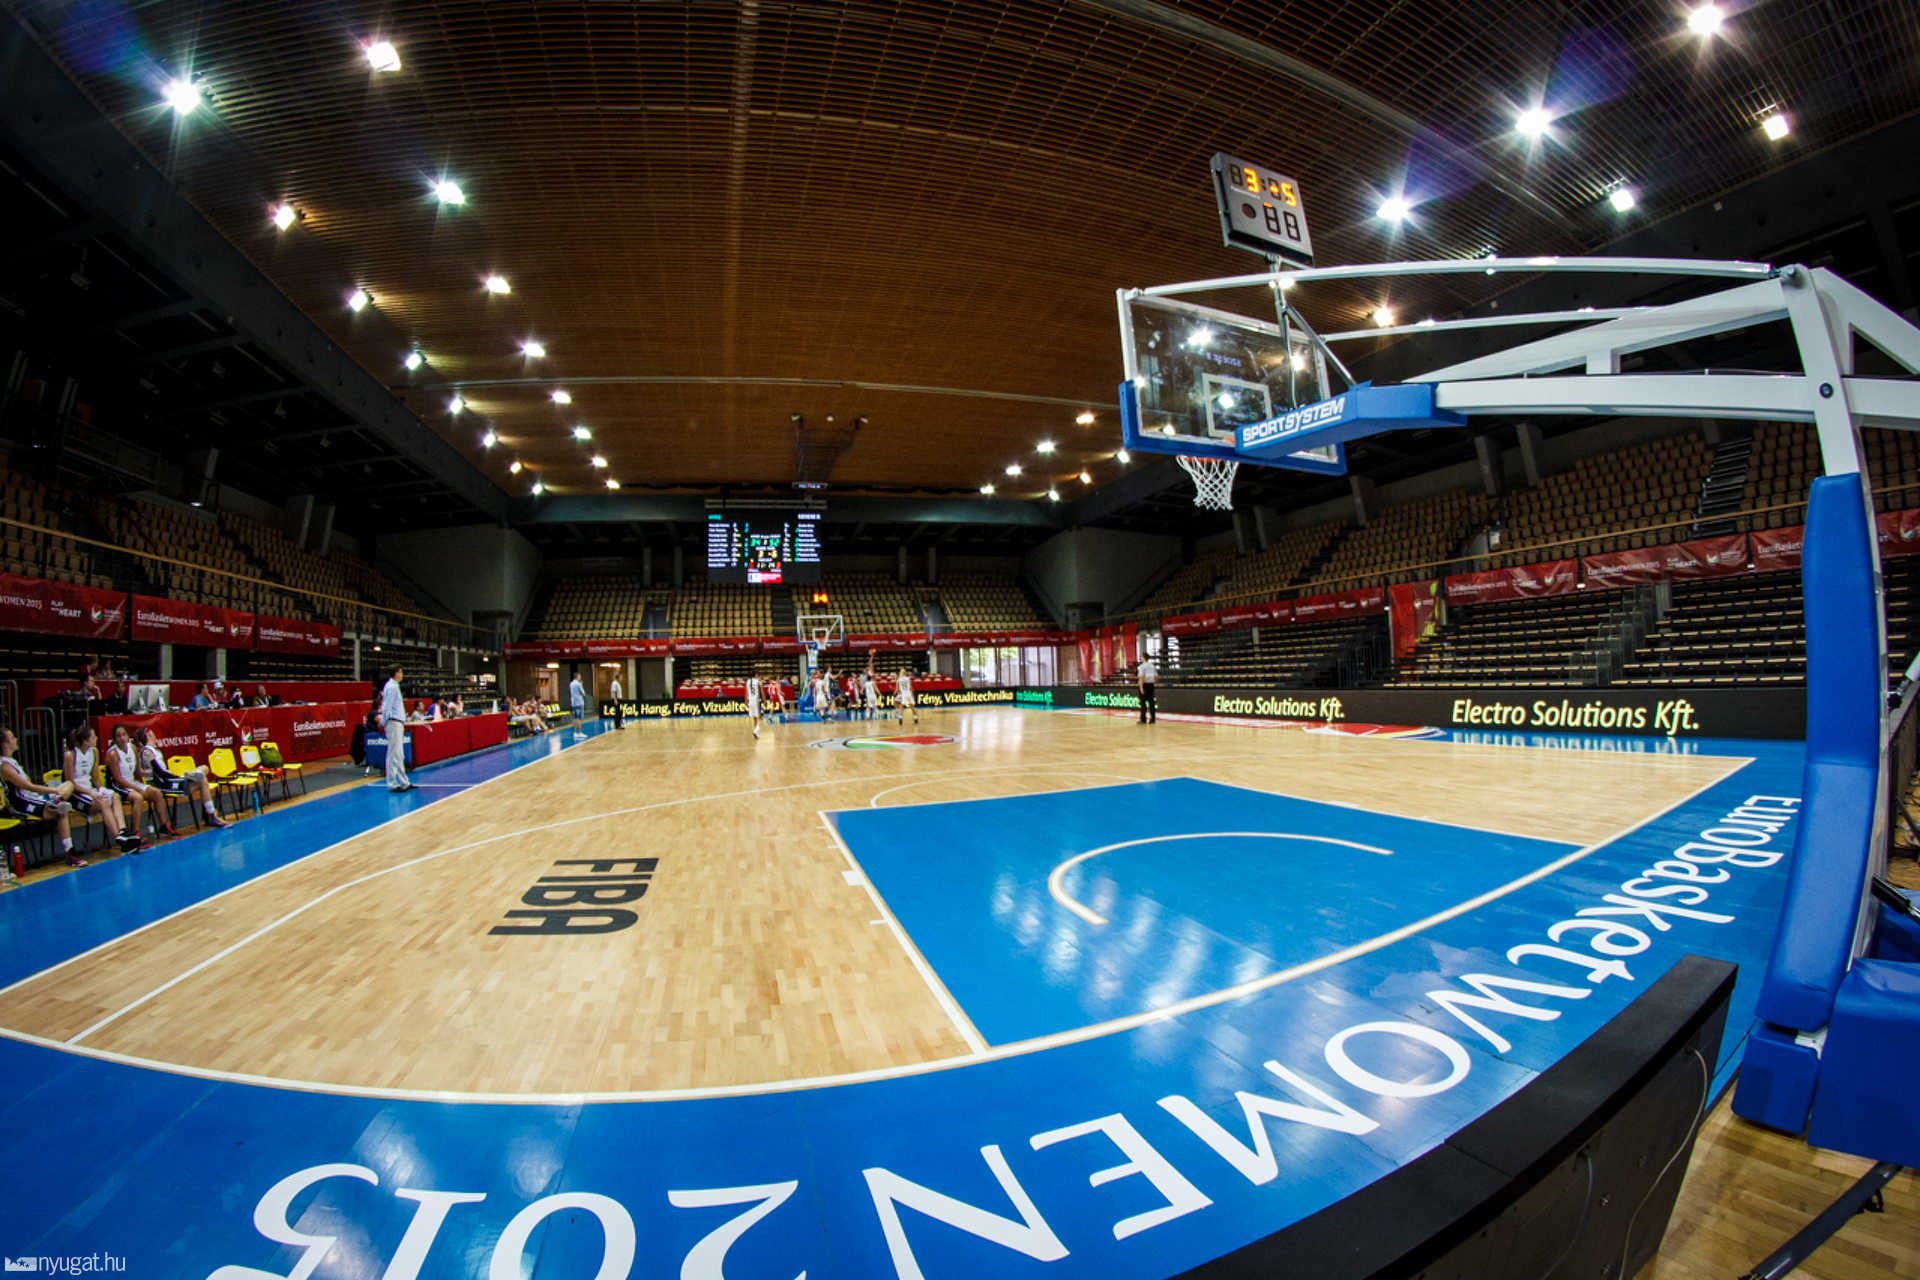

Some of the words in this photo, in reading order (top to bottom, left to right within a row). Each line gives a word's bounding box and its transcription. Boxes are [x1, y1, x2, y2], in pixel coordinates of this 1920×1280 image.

[917, 693, 943, 705] Fény,
[944, 690, 1014, 703] Vizuáltechnika
[1085, 692, 1108, 705] Electro
[641, 702, 671, 717] Hang,
[673, 702, 701, 716] Fény,
[1214, 695, 1253, 714] Electro
[1255, 696, 1317, 717] Solutions
[1320, 696, 1345, 722] Kft.
[1452, 699, 1526, 725] Electro
[1530, 699, 1647, 728] Solutions
[1654, 699, 1699, 735] Kft.
[487, 857, 660, 936] FIBA
